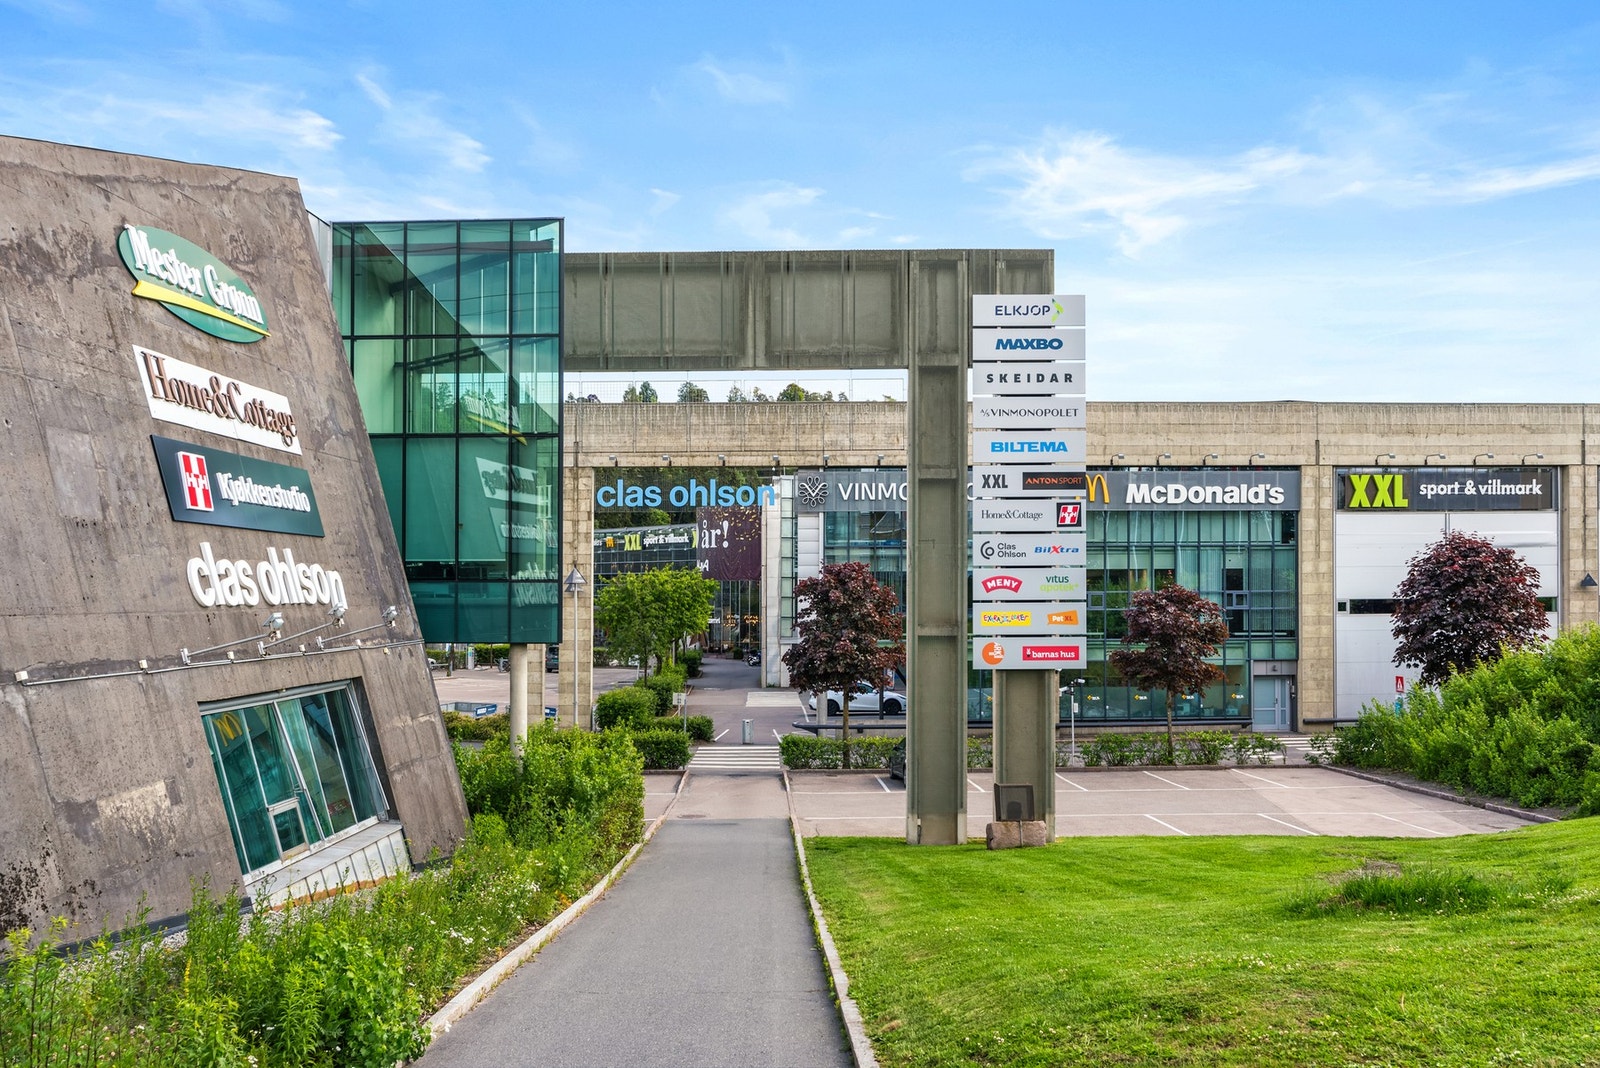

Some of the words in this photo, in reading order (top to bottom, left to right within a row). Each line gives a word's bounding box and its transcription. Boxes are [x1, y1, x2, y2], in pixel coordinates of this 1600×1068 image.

[124, 224, 204, 297] Mester
[995, 338, 1064, 350] MAXBO
[986, 373, 1073, 383] SKEIDAR
[141, 351, 298, 447] Home&Cottage
[991, 408, 1079, 417] VINMONOPOLET
[990, 441, 1069, 453] BILTEMA
[981, 474, 1009, 489] XXL
[216, 472, 311, 512] Kjøkkenstudio
[596, 479, 662, 507] clas
[669, 479, 775, 507] ohlson
[1126, 483, 1285, 504] McDonald's
[1349, 474, 1409, 508] XXL
[1419, 481, 1460, 499] sport
[1464, 480, 1477, 496] &
[1478, 479, 1543, 496] villmark
[981, 510, 1044, 521] Home&Cottage
[701, 520, 729, 549] år!
[624, 533, 642, 551] XXL
[997, 542, 1017, 550] Clas
[997, 550, 1027, 558] Ohlson
[1034, 545, 1080, 554] BilXtra
[187, 542, 260, 608] clas
[256, 547, 348, 610] ohlson
[1045, 575, 1070, 584] vitus
[986, 578, 1019, 590] MENY
[1031, 650, 1059, 658] barnas
[1060, 650, 1075, 658] hus
